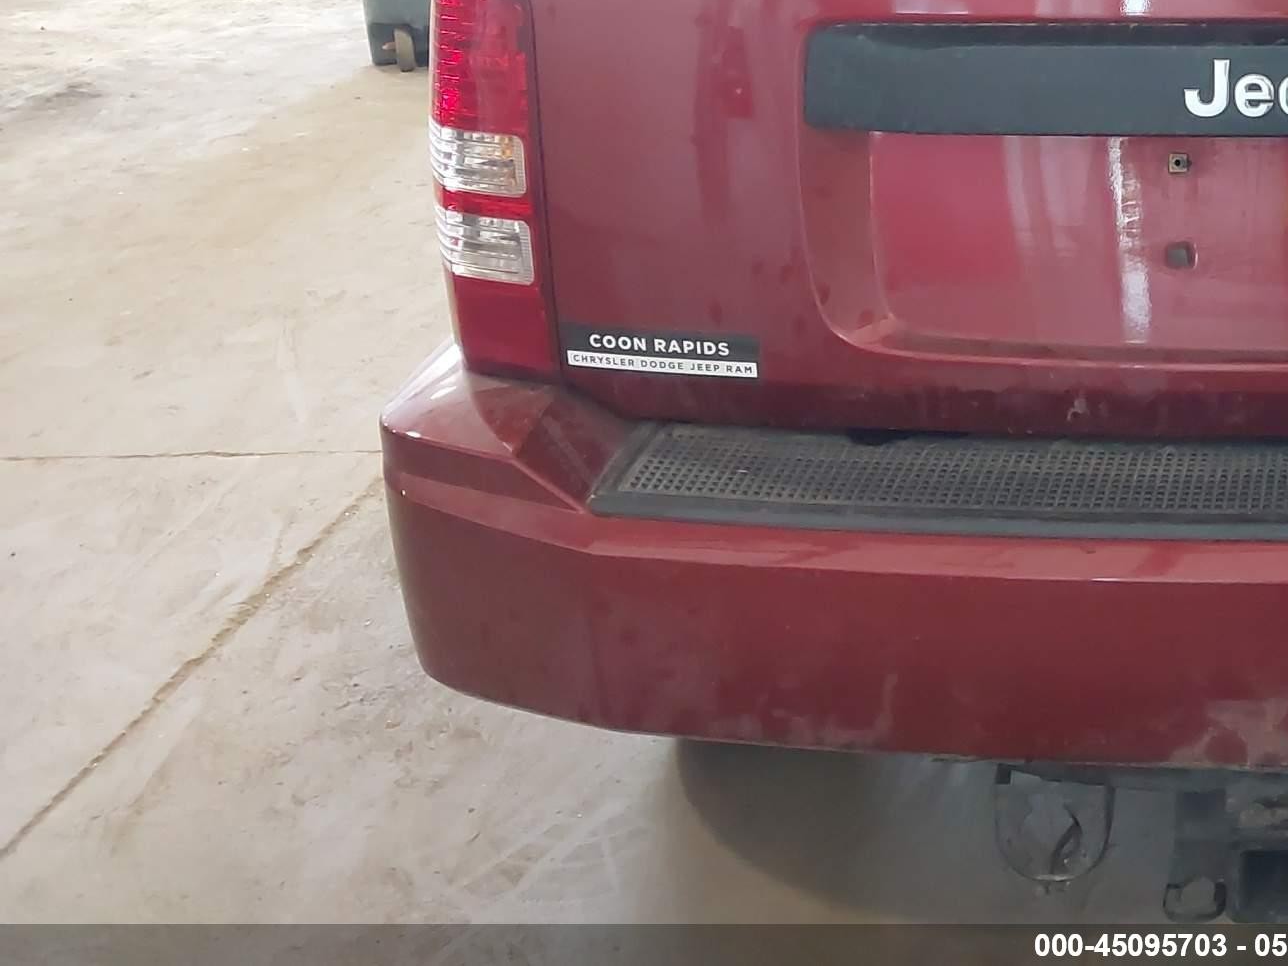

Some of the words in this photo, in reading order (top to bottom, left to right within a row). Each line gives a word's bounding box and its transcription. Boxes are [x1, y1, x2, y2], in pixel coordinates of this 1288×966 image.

[589, 333, 647, 351] COON
[655, 338, 730, 356] RAPIDS
[573, 353, 635, 367] CHRYSLER
[641, 359, 685, 370] DODGE
[690, 363, 721, 372] JEEP
[726, 365, 753, 374] RAM
